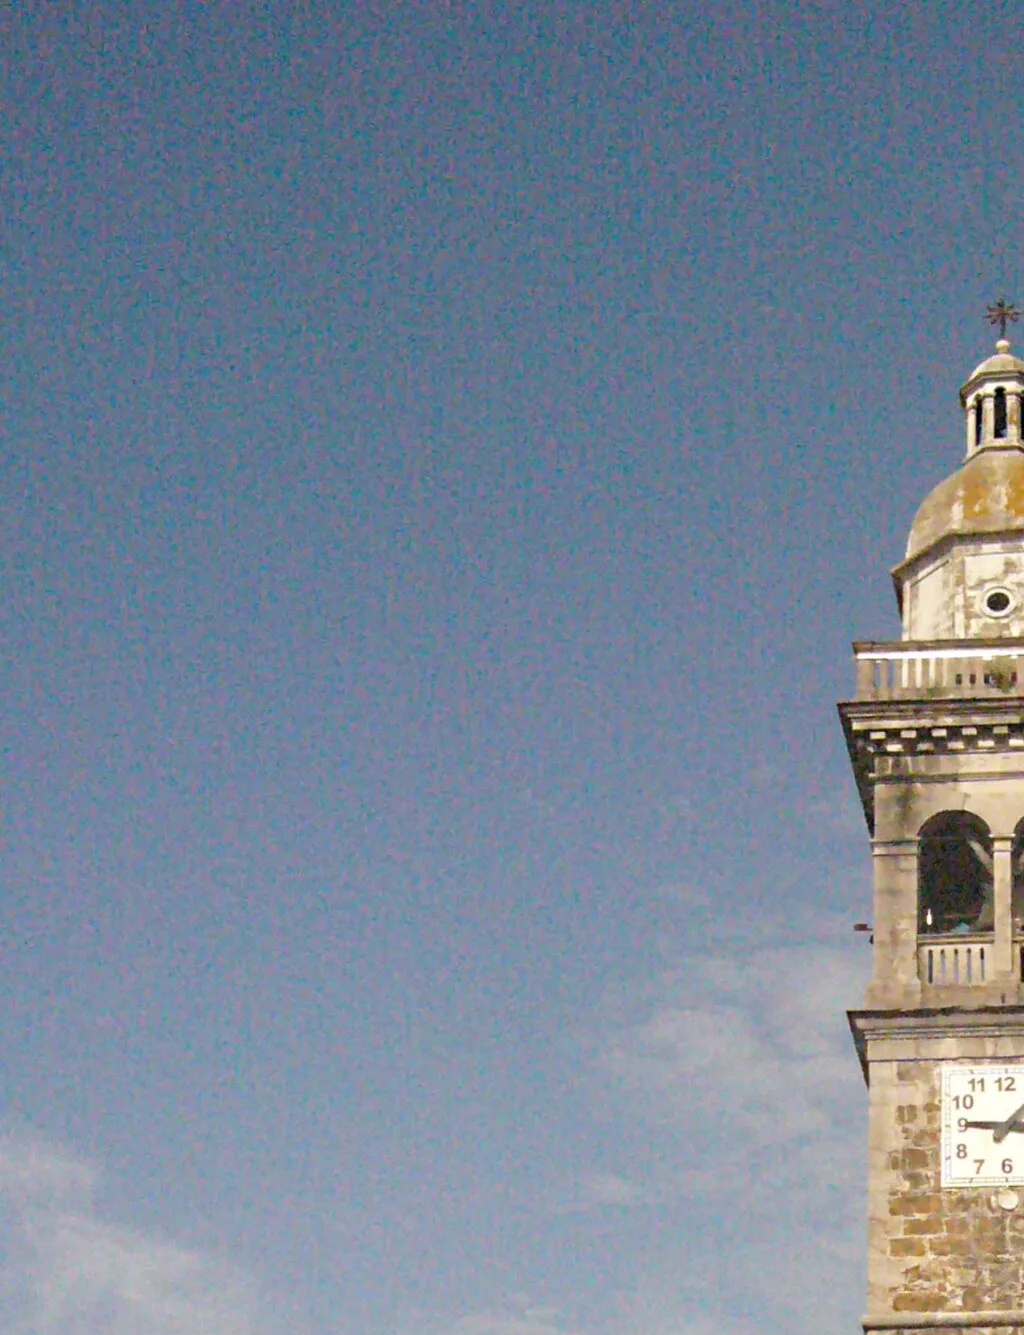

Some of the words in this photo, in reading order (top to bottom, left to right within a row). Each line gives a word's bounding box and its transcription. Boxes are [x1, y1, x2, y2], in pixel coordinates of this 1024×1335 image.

[968, 1078, 986, 1092] 11
[994, 1077, 1016, 1092] 12
[952, 1094, 974, 1110] 10
[957, 1117, 968, 1133] 9
[956, 1143, 968, 1159] 8
[973, 1159, 985, 1174] 7
[1001, 1158, 1013, 1174] 6
